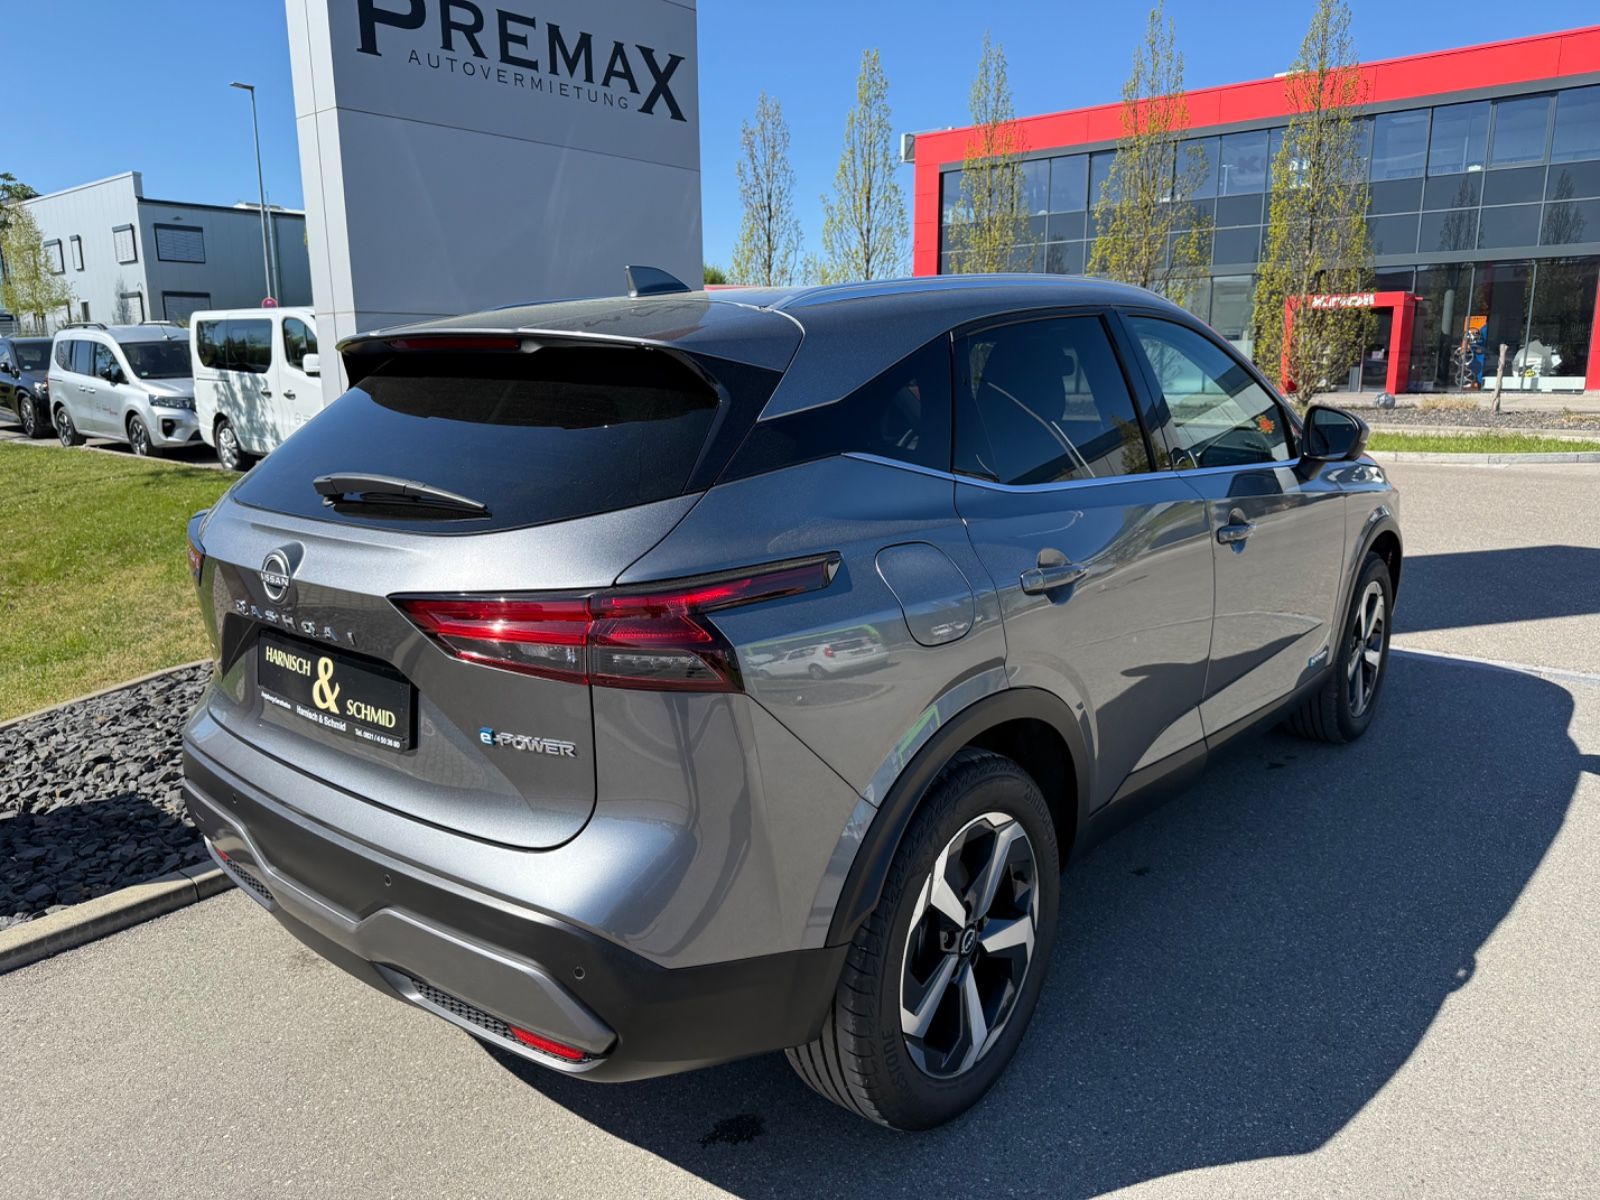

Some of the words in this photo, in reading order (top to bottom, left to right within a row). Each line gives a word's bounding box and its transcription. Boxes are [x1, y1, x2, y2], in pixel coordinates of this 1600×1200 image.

[356, 0, 687, 122] PREMAX
[408, 49, 629, 110] AUTOVERMIETUNG
[261, 572, 290, 586] ISSAN
[235, 600, 356, 645] QASHQAI
[265, 646, 311, 676] HARNISCH
[312, 656, 340, 714] &
[346, 698, 396, 728] SCHMID
